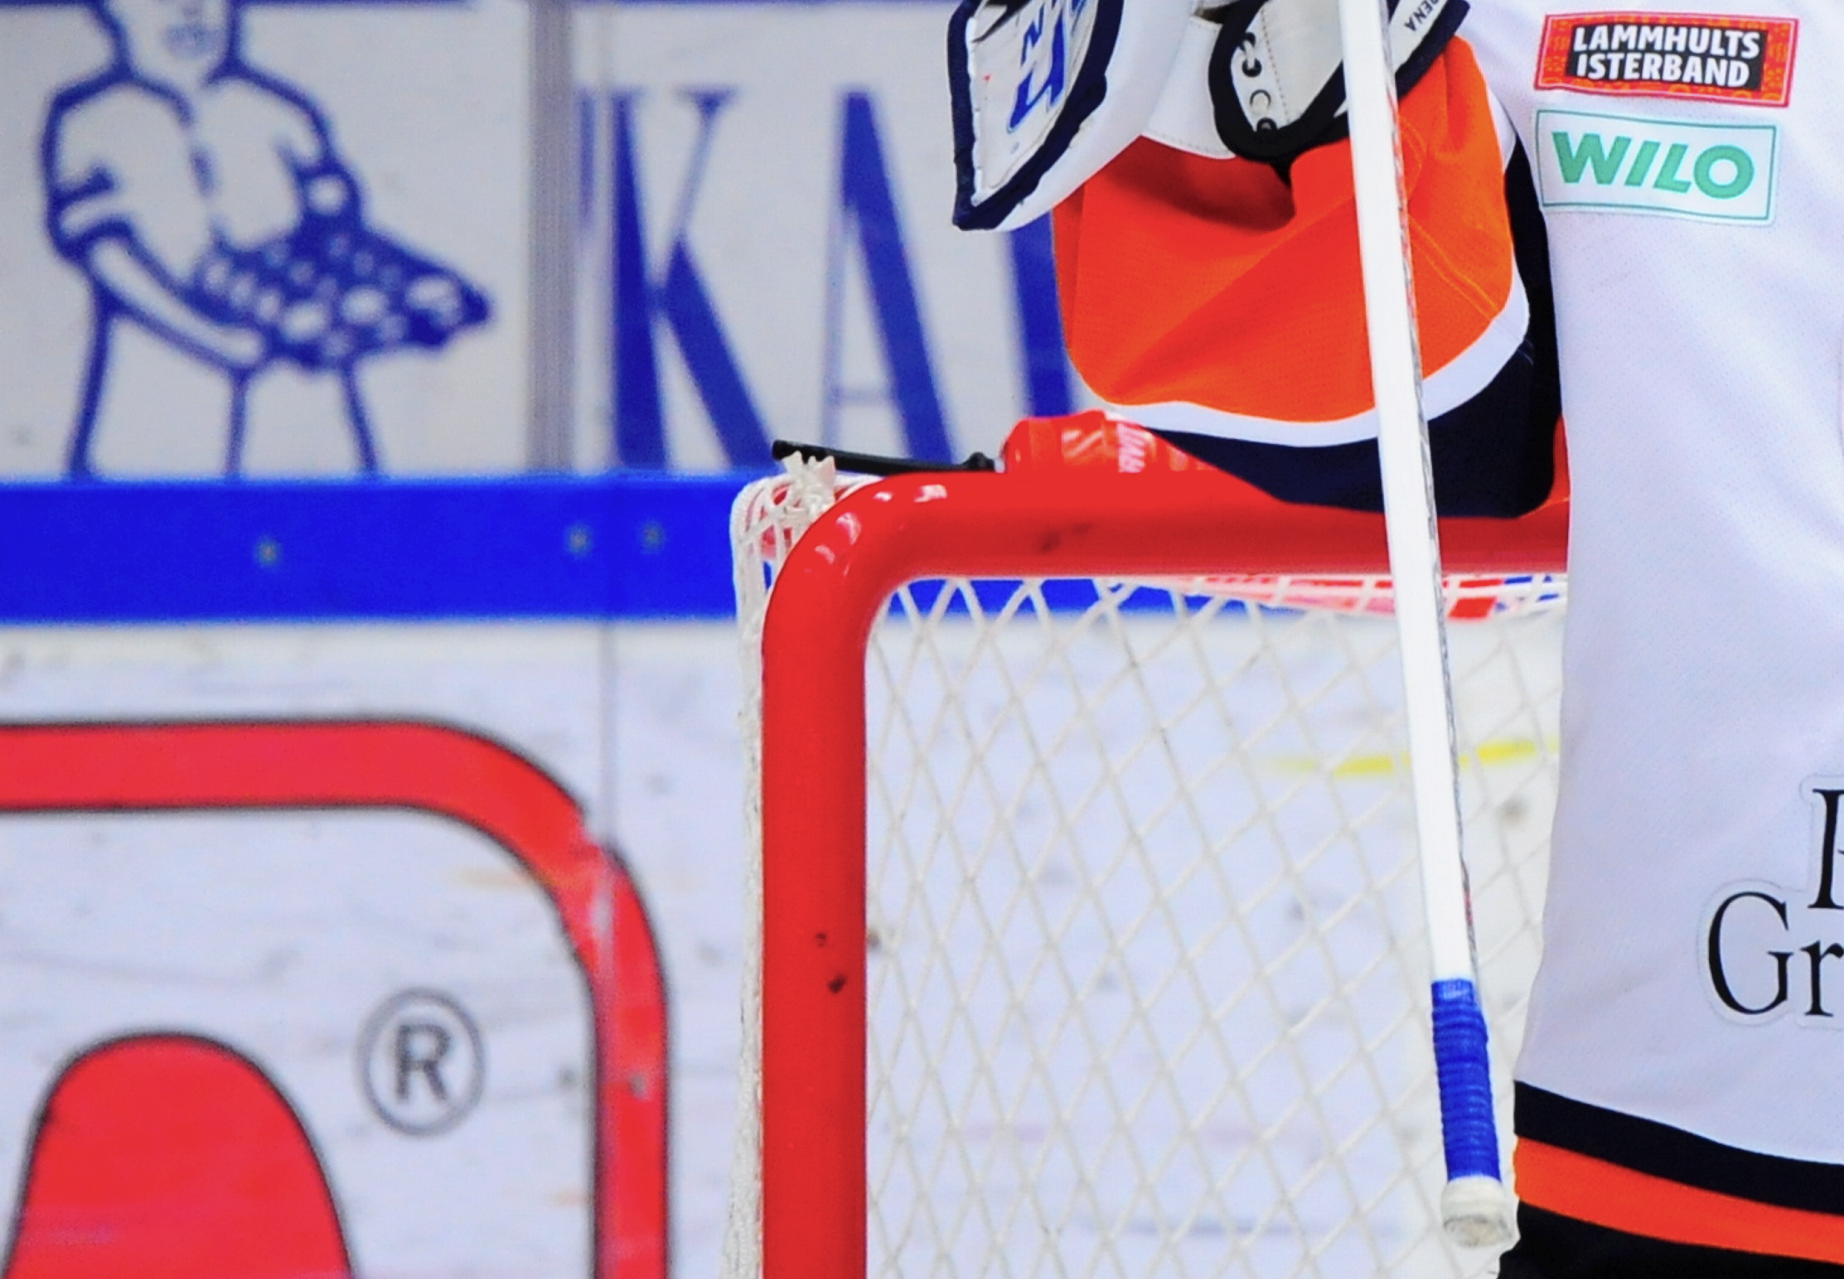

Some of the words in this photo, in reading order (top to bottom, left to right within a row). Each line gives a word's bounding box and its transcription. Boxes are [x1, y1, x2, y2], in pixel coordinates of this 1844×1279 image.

[1573, 24, 1761, 60] LAMMHULTS
[1576, 52, 1751, 89] ISTERBAND
[1552, 130, 1756, 200] WILO
